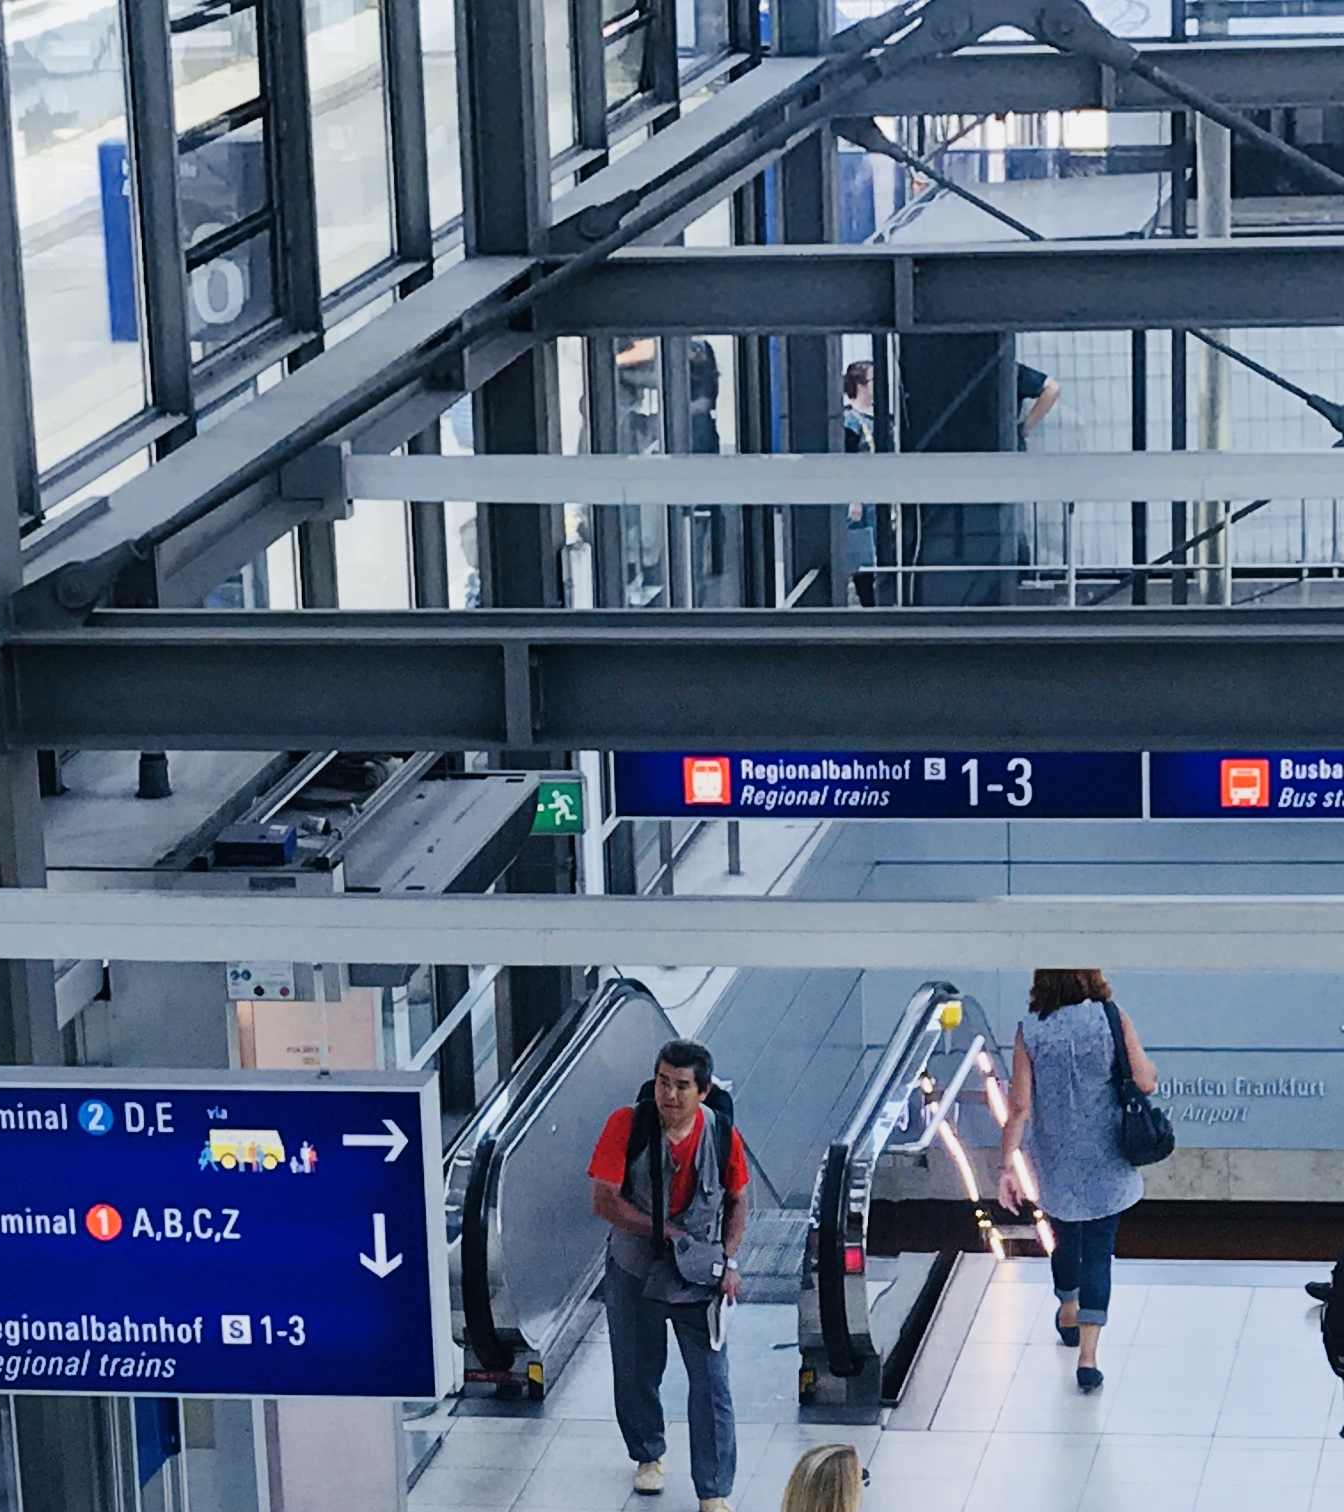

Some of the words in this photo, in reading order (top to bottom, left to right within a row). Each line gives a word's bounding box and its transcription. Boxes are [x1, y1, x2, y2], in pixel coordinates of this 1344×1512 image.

[739, 758, 912, 786] Regionalbahnhof
[960, 756, 1034, 807] 1-3
[739, 785, 828, 811] Regional
[833, 785, 891, 807] trains
[1277, 787, 1317, 808] Bus
[1234, 1075, 1327, 1098] Frankfurt
[123, 1101, 175, 1137] D,E
[207, 1105, 229, 1120] via
[1179, 1103, 1250, 1126] Airport
[132, 1207, 242, 1243] A,B,C,Z
[259, 1314, 307, 1347] 1-3
[98, 1350, 177, 1380] trains
